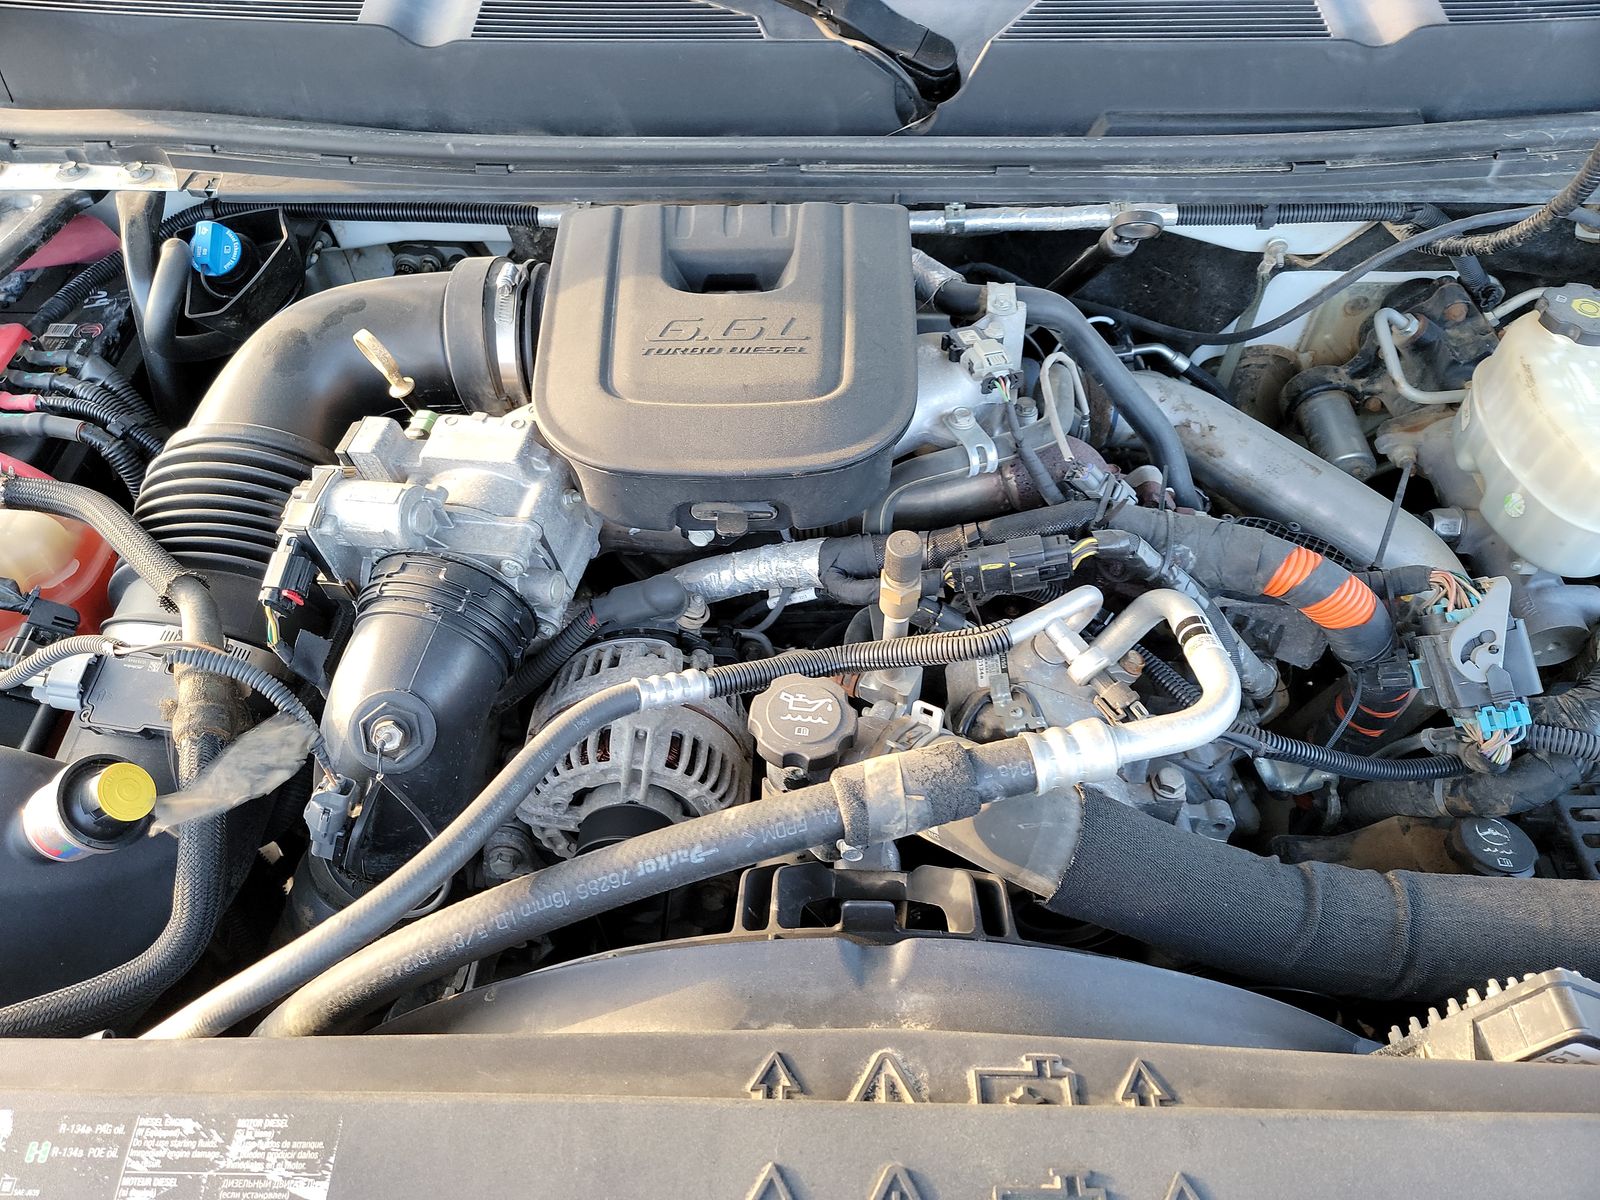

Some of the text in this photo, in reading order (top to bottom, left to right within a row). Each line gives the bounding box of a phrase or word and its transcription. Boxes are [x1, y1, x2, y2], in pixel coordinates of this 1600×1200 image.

[645, 317, 811, 341] 6.6L
[641, 346, 808, 356] TURBO DIESEL
[637, 846, 721, 878] Parker
[59, 1123, 92, 1134] R-134a
[94, 1122, 113, 1134] PAG
[51, 1146, 84, 1158] R-134a
[87, 1147, 106, 1158] POE
